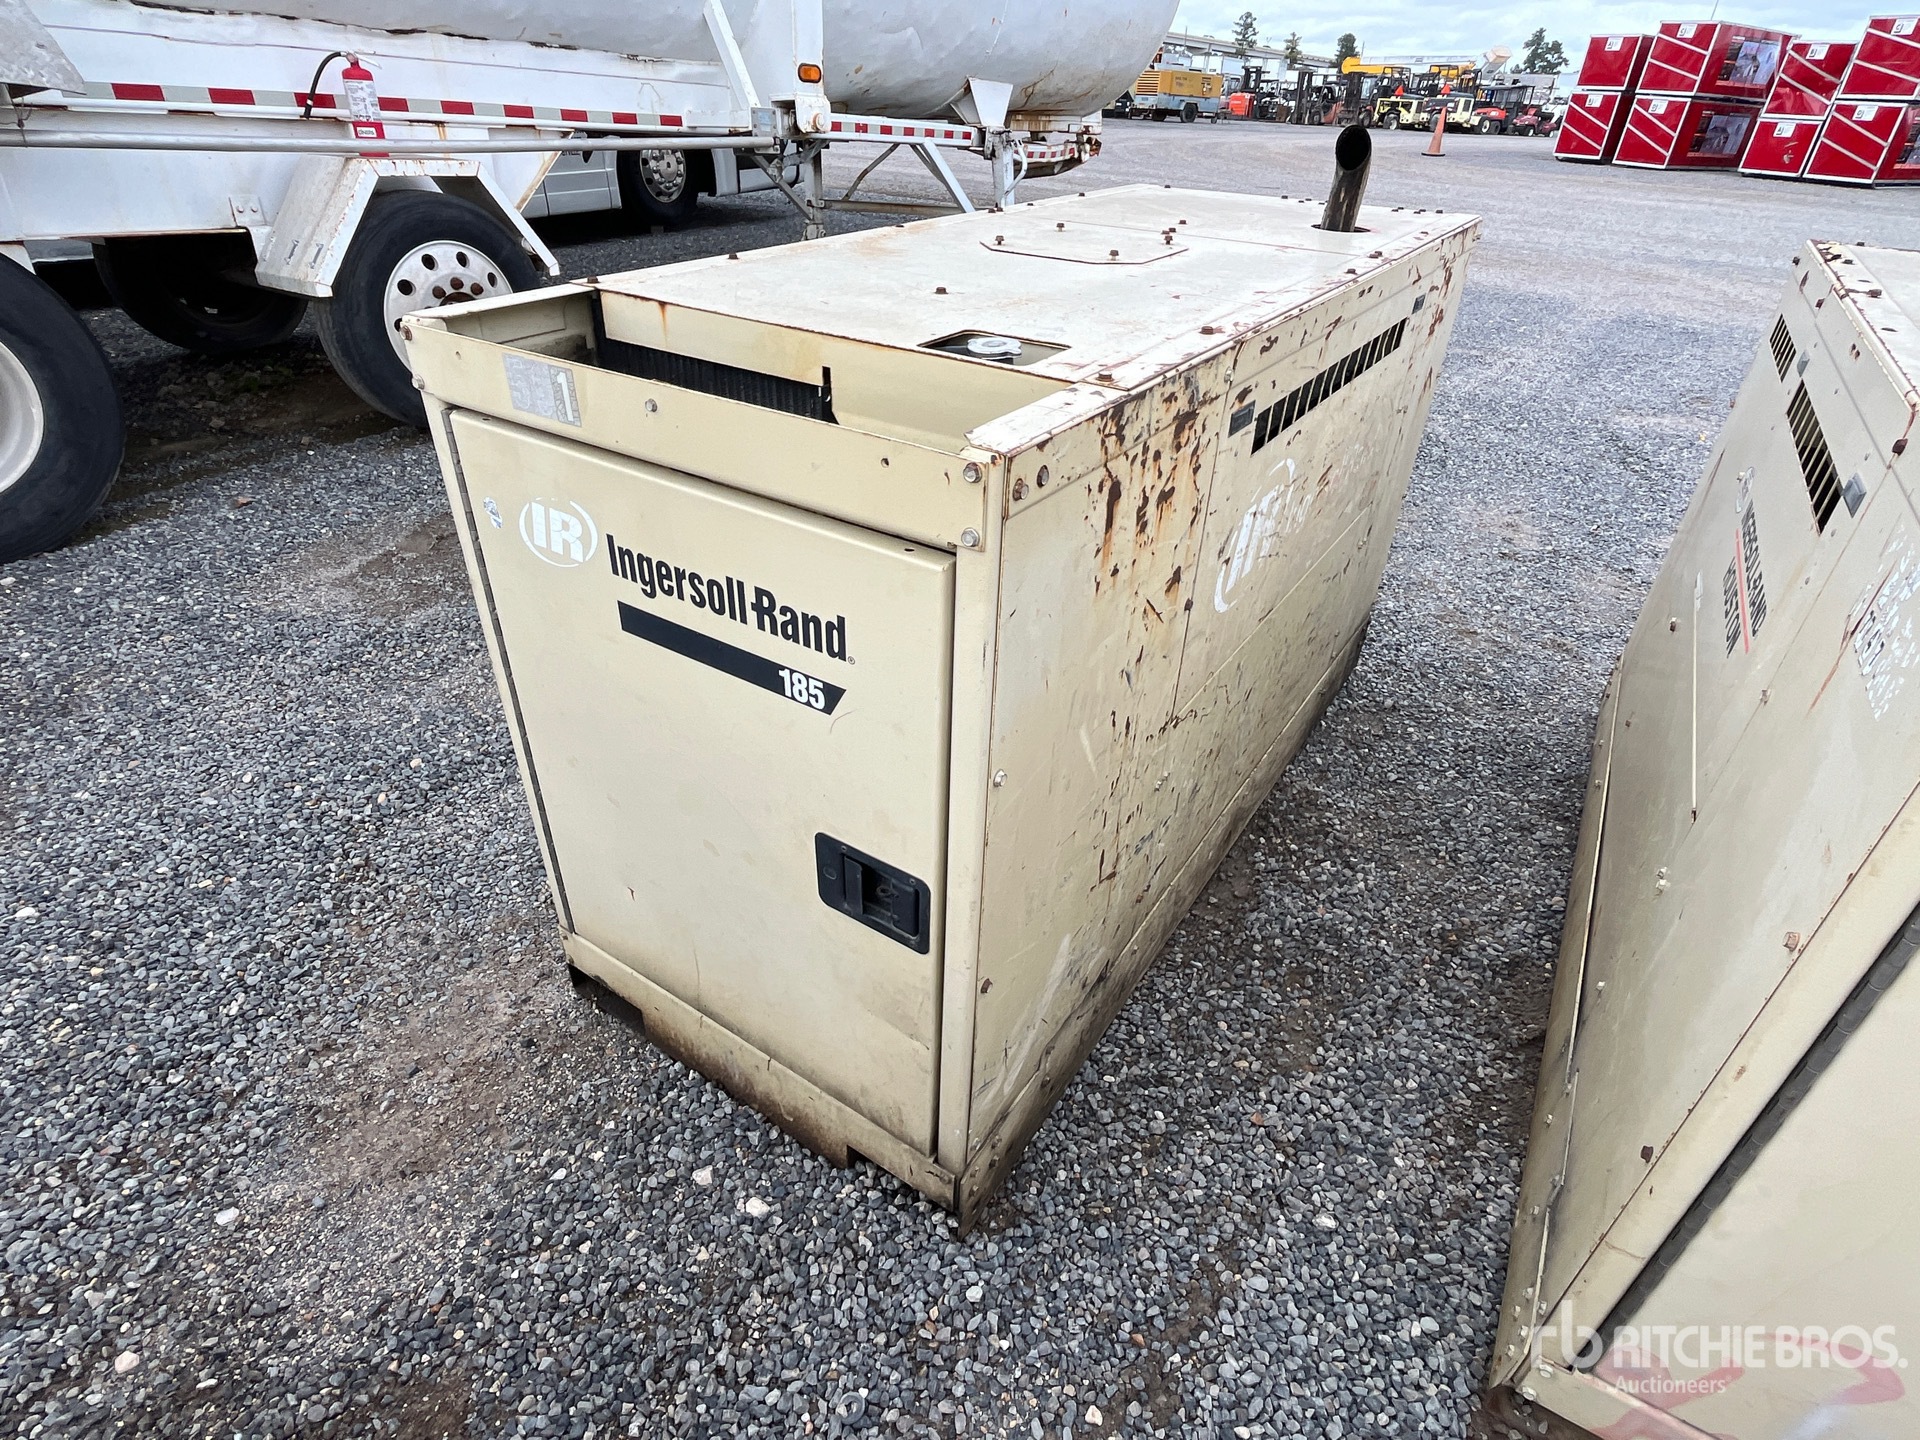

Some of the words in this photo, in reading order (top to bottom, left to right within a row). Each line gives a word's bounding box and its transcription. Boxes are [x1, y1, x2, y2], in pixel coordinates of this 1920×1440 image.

[556, 371, 574, 422] 1
[531, 501, 583, 563] IR
[1723, 556, 1741, 659] HOUSTON
[778, 668, 826, 710] 185
